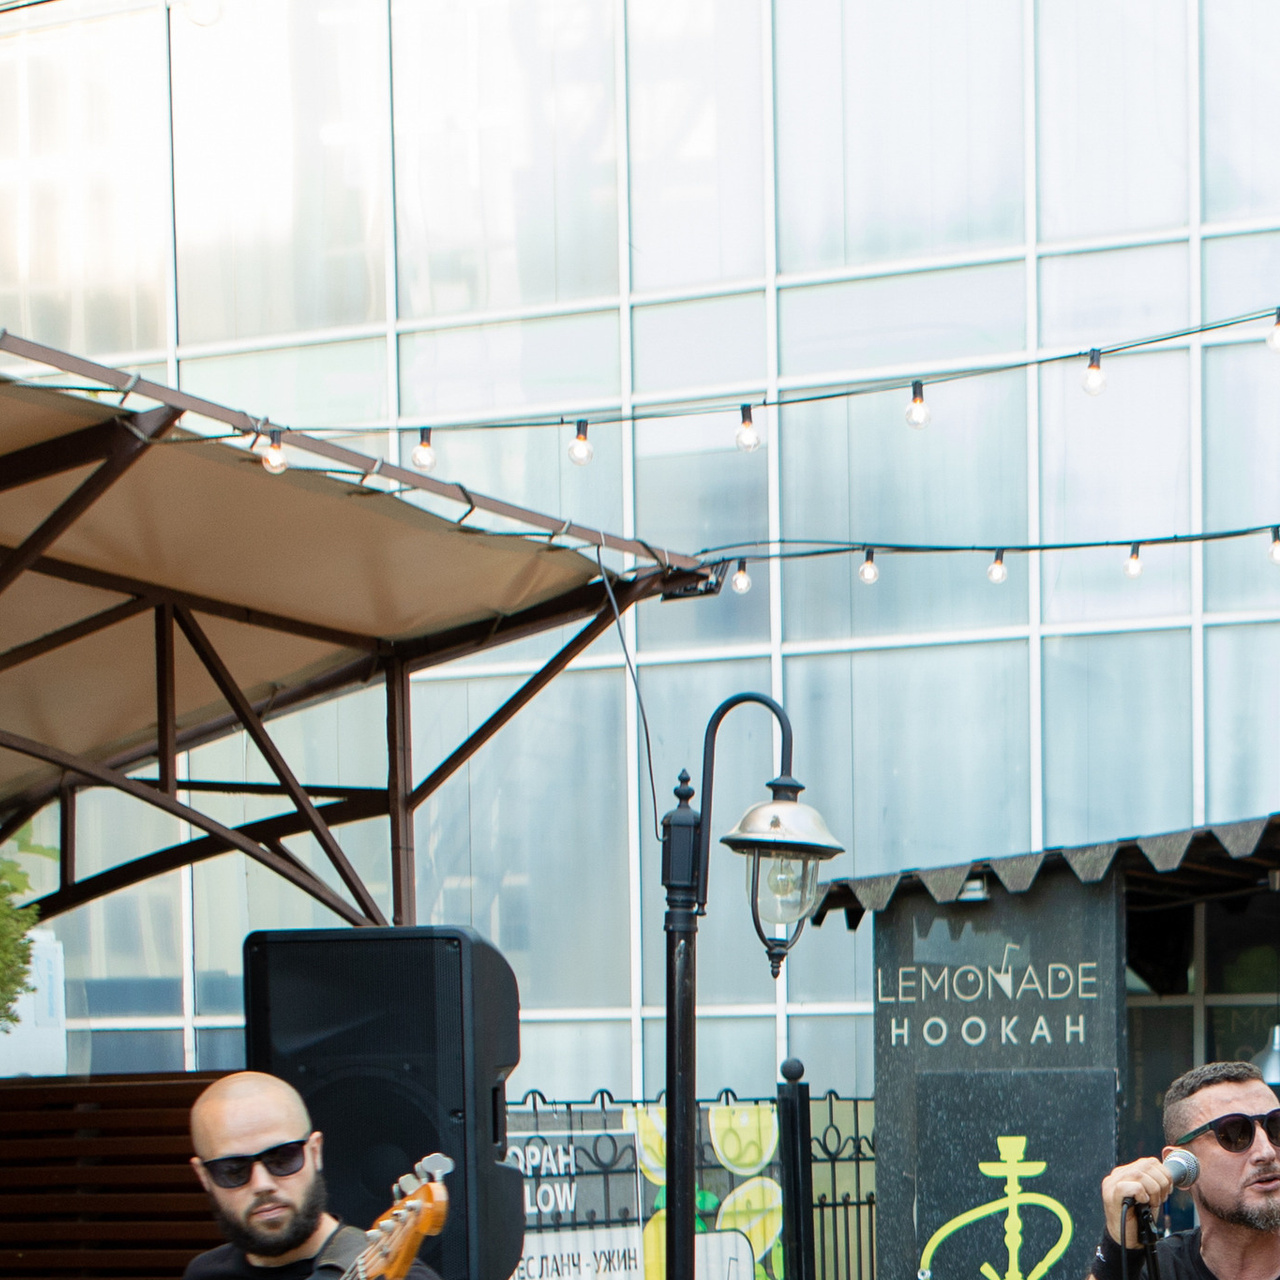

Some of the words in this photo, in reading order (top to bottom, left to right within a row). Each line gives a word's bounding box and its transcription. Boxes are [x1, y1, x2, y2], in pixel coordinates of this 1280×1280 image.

[877, 961, 1099, 1004] LEMONADE
[890, 1014, 1085, 1048] HOOKAH
[539, 1251, 582, 1280] ЛАНЧ
[593, 1246, 638, 1275] УЖИН
